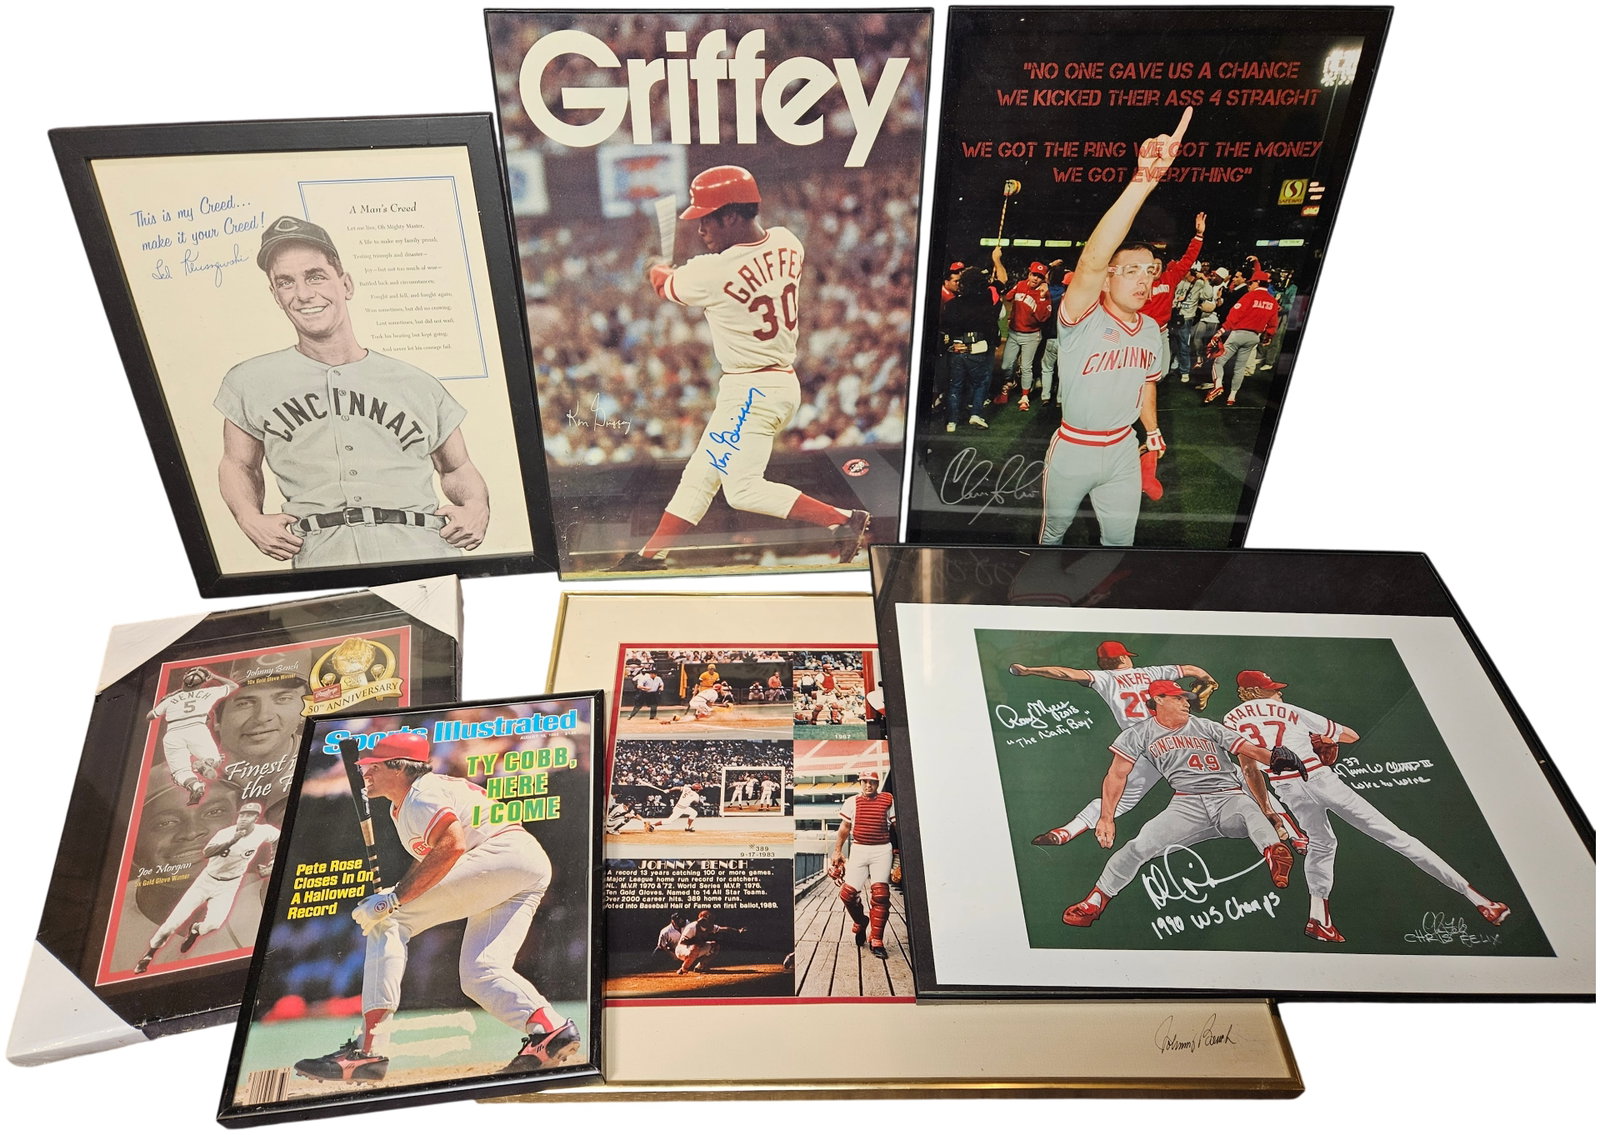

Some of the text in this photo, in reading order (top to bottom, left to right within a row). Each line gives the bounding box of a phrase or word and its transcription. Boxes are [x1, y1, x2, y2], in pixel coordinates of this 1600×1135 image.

[1024, 62, 1300, 79] "NO ONE GAVE US A CHANCE
[519, 29, 910, 168] Griffey
[998, 89, 1321, 106] WE KICKED THEIR ASS 4 STRAIGHT
[962, 142, 1322, 158] WE GOT THE RING WE GOT THE MONEY
[1053, 167, 1252, 182] WE GOT EVERYTHING"
[130, 195, 250, 227] This is my Creed...
[350, 202, 416, 214] A Man's Creed
[142, 235, 172, 251] make
[178, 232, 186, 244] it
[192, 229, 218, 245] your
[724, 248, 803, 304] GRIFFE
[748, 282, 798, 341] 30
[263, 387, 424, 452] CINCINNATI
[184, 700, 196, 713] 5
[327, 682, 398, 711] ANNIVERSARY
[433, 709, 578, 743] Illustrated
[1224, 703, 1299, 732] CHARLTON
[1239, 721, 1286, 748] 37
[1148, 736, 1217, 758] CINCINNATI
[225, 754, 287, 780] Finest
[467, 747, 578, 777] TY COBB,
[1187, 754, 1221, 772] 49
[242, 776, 272, 800] the
[486, 773, 549, 799] HERE
[472, 796, 561, 828] I COME
[138, 862, 192, 878] Joe Morgan
[297, 858, 362, 876] Pete Rose
[638, 860, 748, 869] JOHNNY BENCH
[294, 870, 374, 890] Closes In On
[291, 885, 365, 905] A Hallowed
[288, 903, 337, 920] Record
